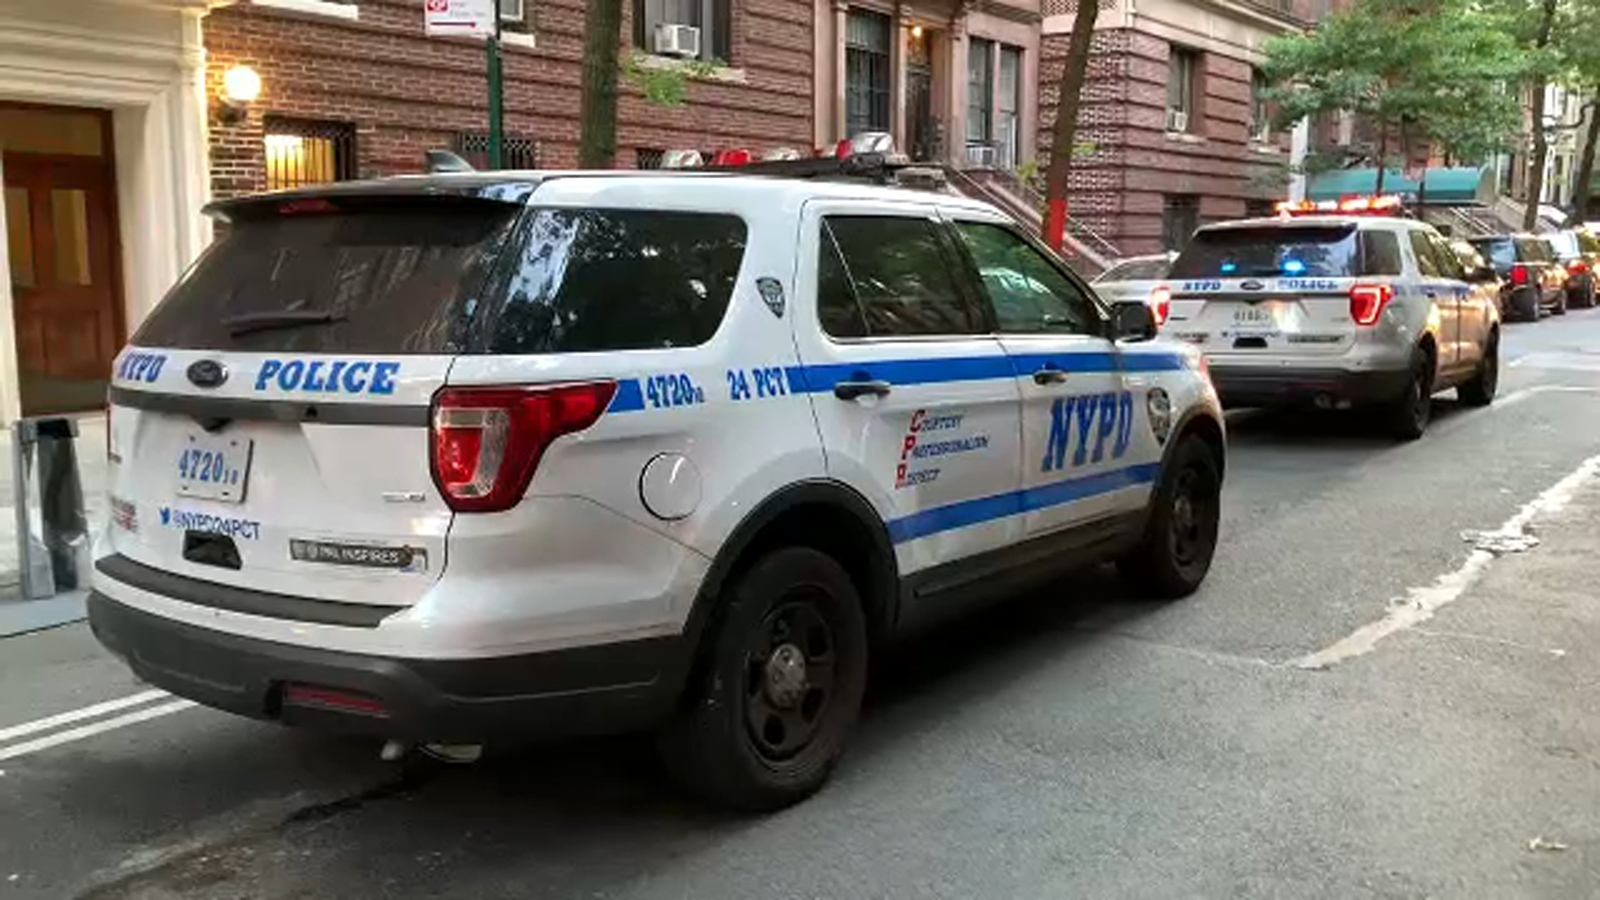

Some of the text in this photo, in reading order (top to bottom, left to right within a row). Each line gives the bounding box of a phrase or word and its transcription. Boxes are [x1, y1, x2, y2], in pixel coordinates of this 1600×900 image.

[118, 353, 168, 383] NYPD
[254, 359, 401, 395] POLICE
[727, 369, 750, 400] 24
[752, 366, 787, 398] PCT
[1041, 389, 1134, 472] NYPD
